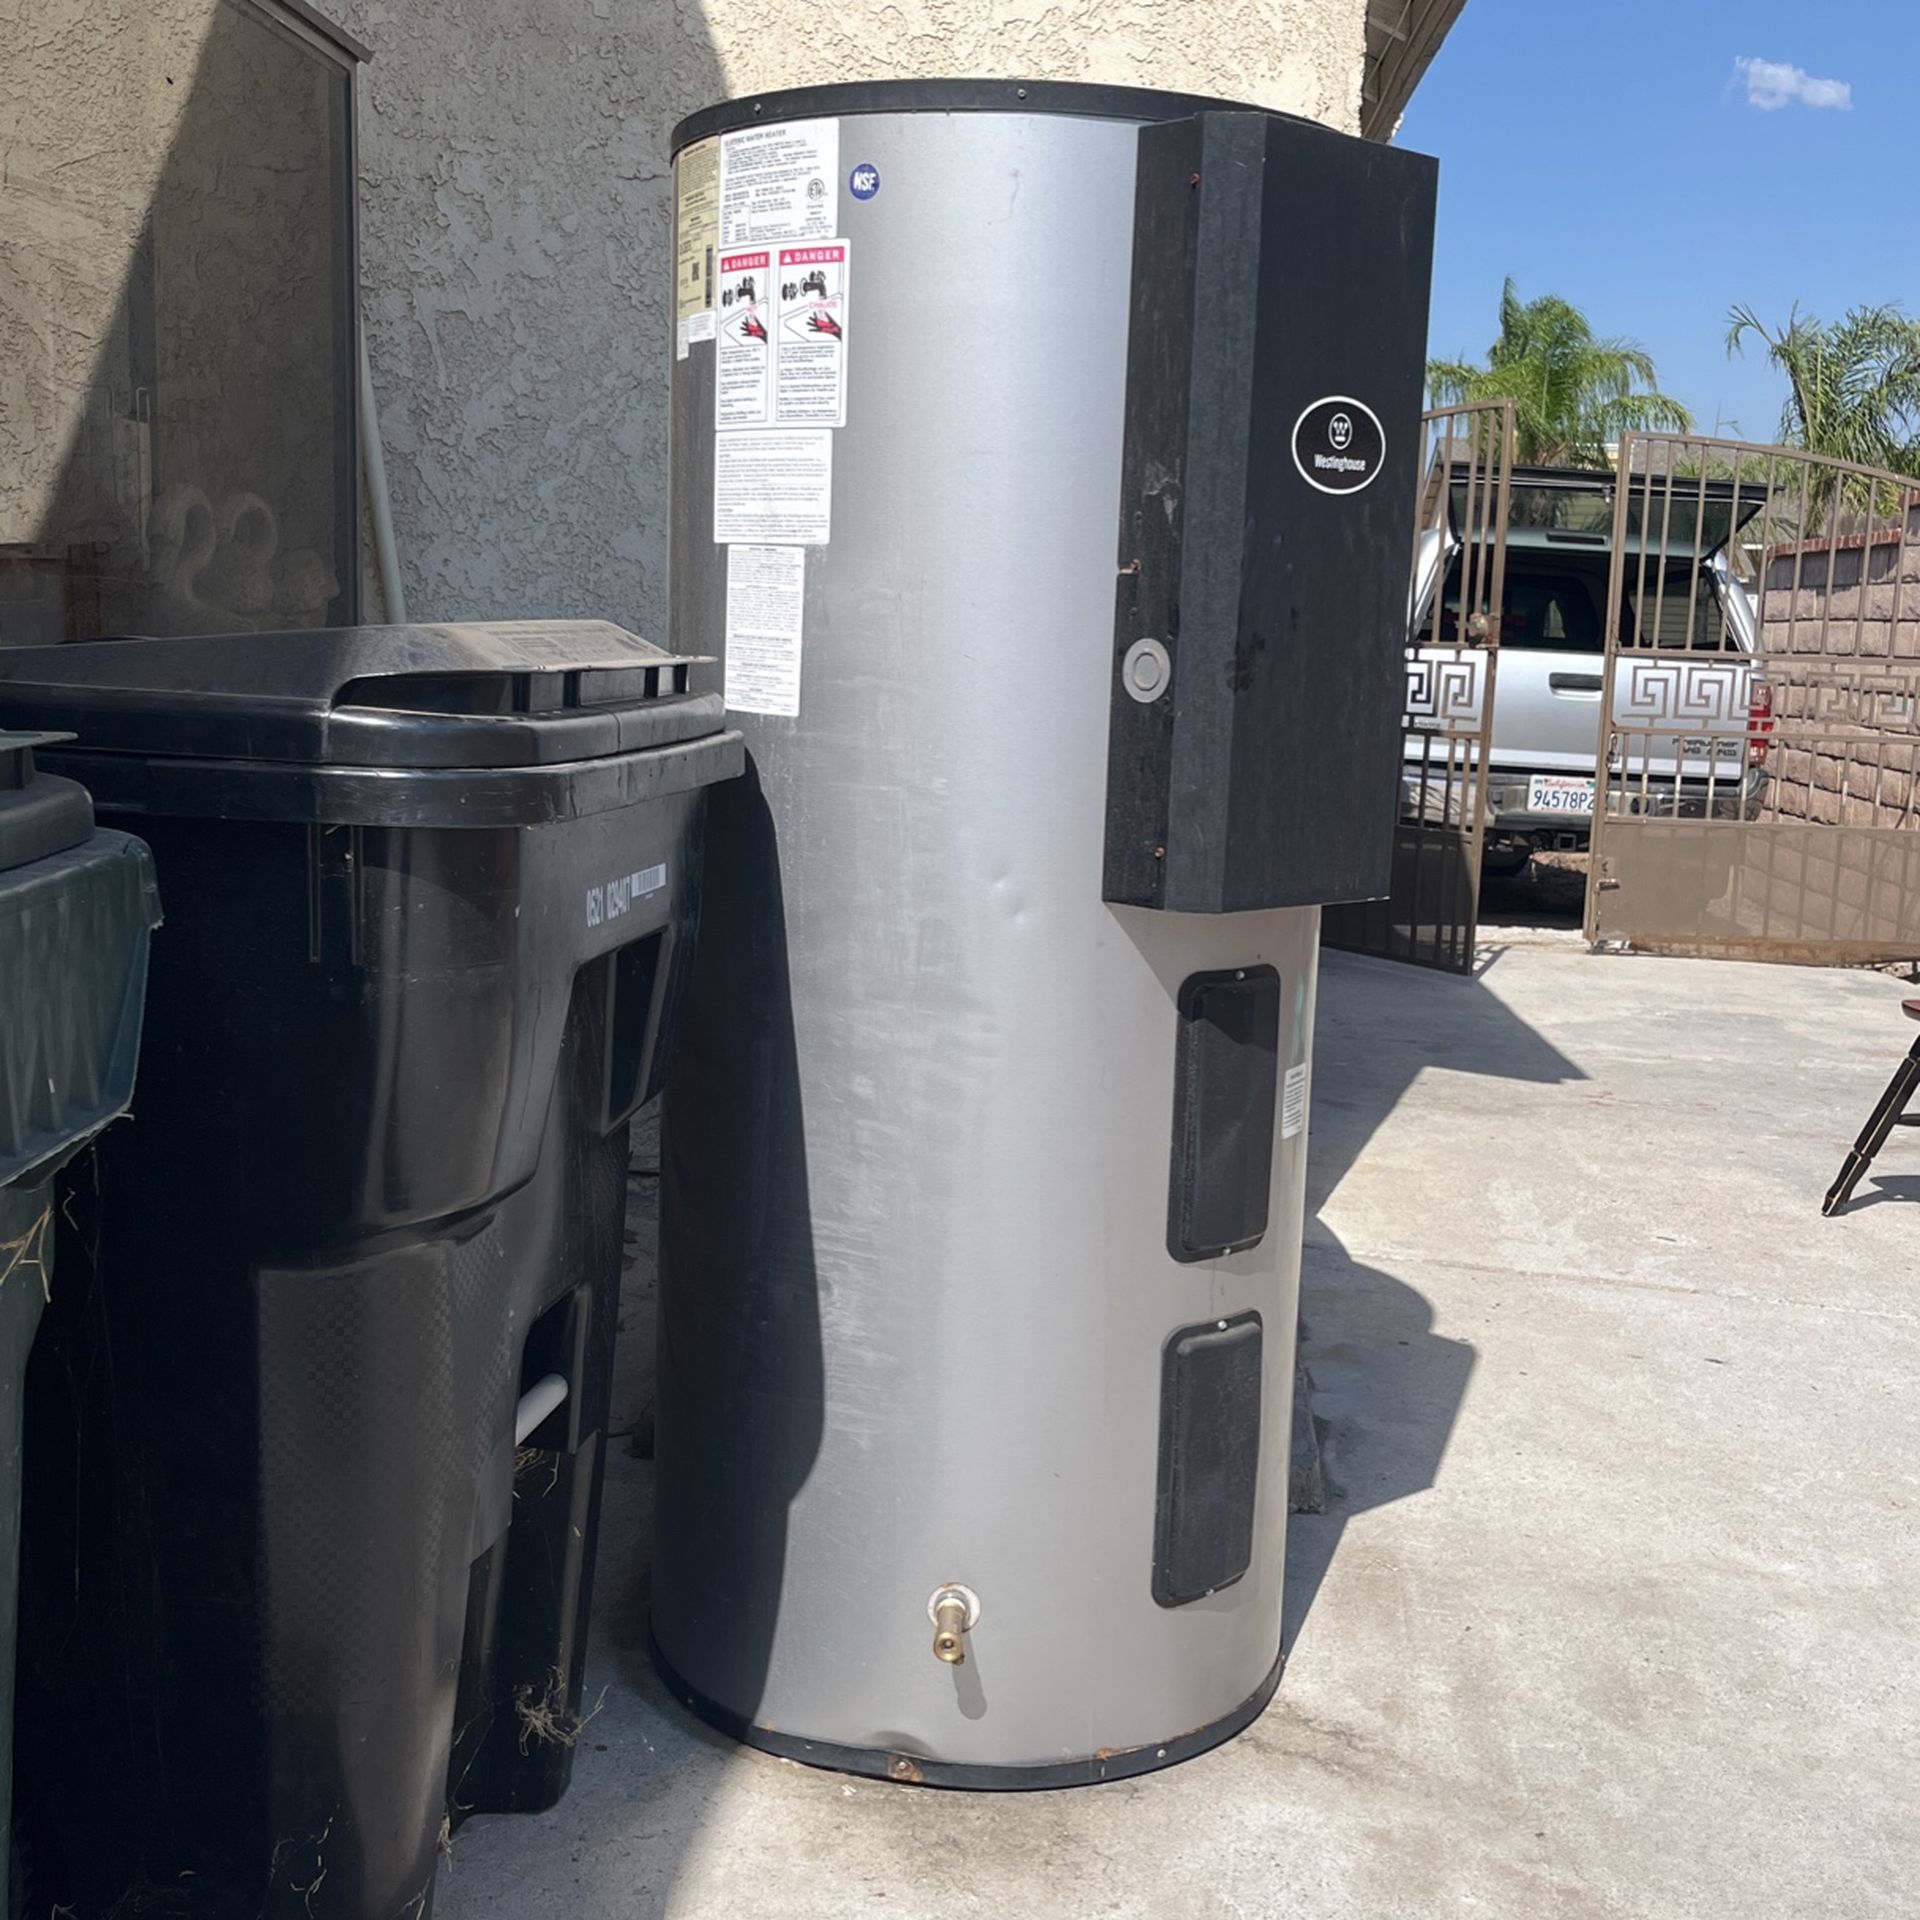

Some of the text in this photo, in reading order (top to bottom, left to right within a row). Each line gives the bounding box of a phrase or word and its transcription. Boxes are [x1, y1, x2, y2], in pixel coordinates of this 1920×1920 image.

[765, 129, 787, 139] HEATER
[853, 171, 877, 192] NSF
[731, 255, 766, 269] DANGER
[794, 249, 840, 262] DANGER
[1314, 454, 1366, 472] Westinghouse
[1533, 790, 1596, 810] 94578P2
